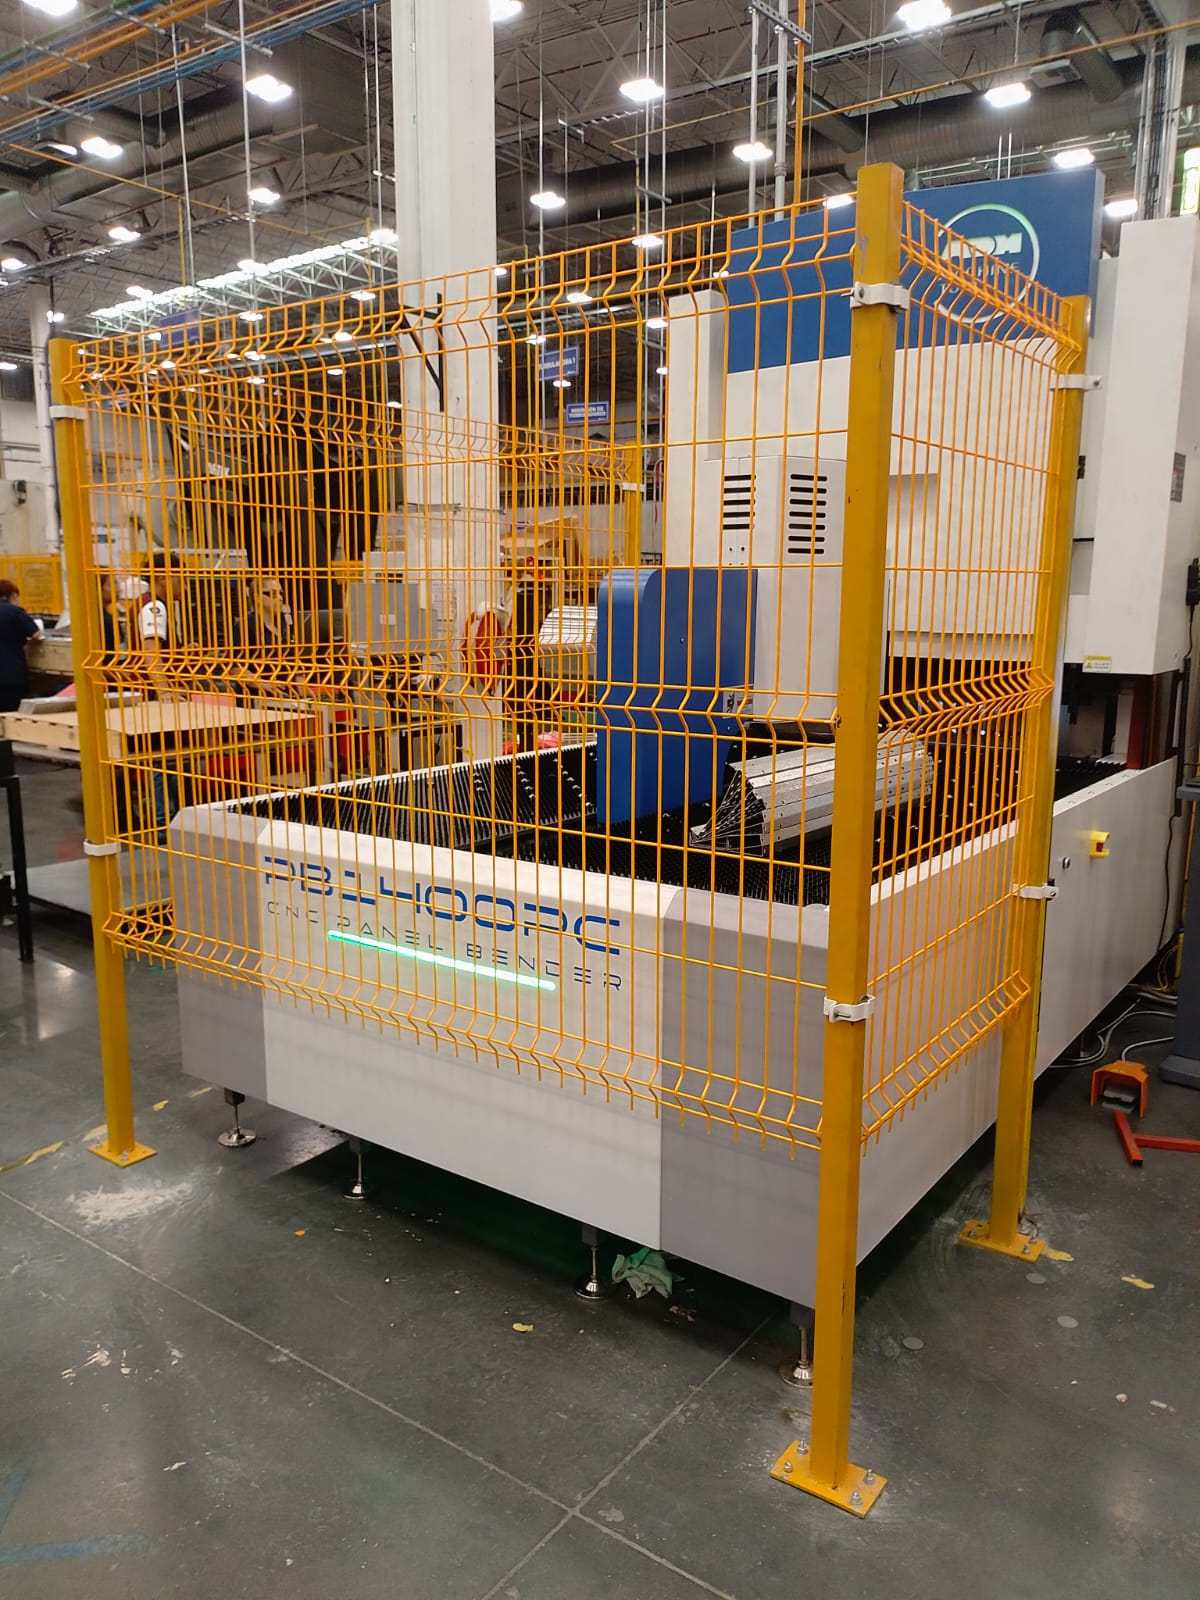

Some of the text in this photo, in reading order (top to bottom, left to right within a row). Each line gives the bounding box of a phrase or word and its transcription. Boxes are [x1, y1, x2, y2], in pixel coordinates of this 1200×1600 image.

[267, 901, 622, 991] CNC PANEL BENDER
